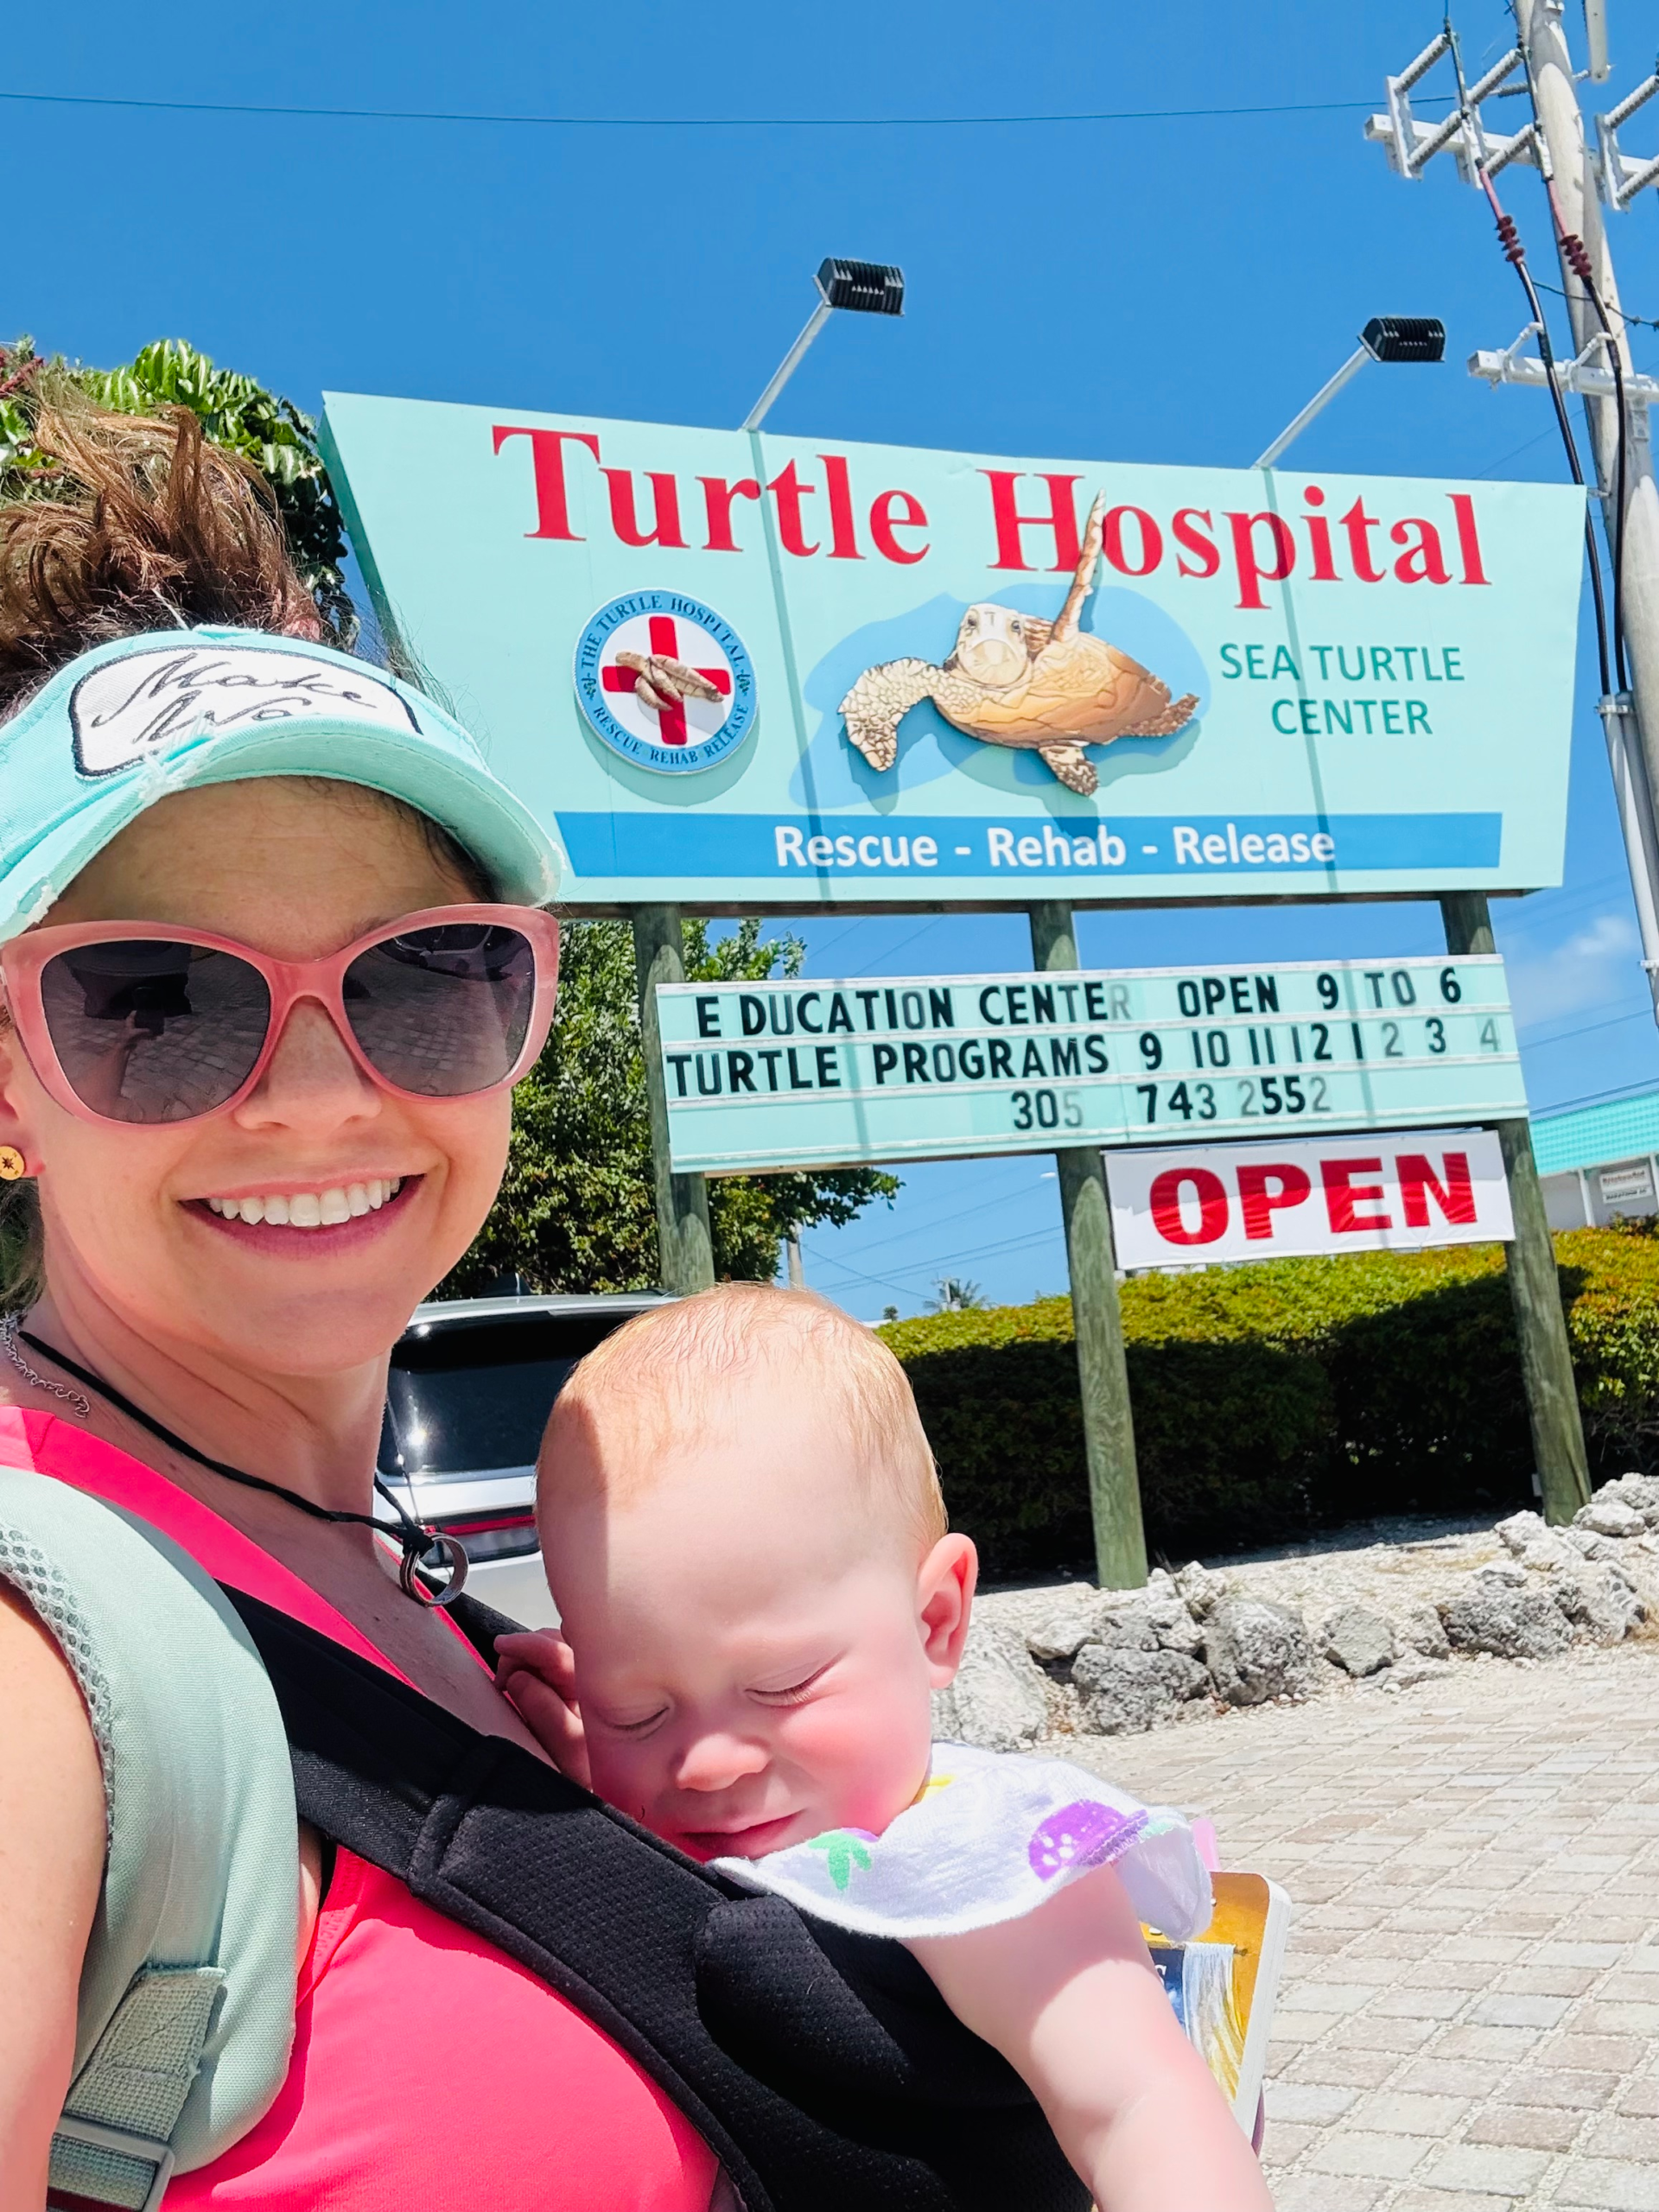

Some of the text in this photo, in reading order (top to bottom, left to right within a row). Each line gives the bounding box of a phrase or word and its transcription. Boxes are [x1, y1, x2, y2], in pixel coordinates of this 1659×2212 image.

[492, 424, 1492, 610] Turtle Hospital
[581, 594, 747, 669] THE TURTLE HOSPITAL
[1219, 643, 1465, 682] SEA TURTLE
[593, 703, 749, 764] RESCUE REHAB RELEASE
[1271, 699, 1433, 734] CENTER
[775, 825, 938, 868] Rescue
[987, 824, 1126, 866] Rehab
[1173, 823, 1336, 864] Release
[979, 982, 1131, 1025] CENTER
[1177, 975, 1281, 1018] OPEN
[1317, 973, 1339, 1009] 9
[1364, 969, 1417, 1009] TO
[1440, 966, 1462, 1003] 6
[666, 1046, 841, 1096] TURTLE
[873, 1033, 1109, 1085] PROGRAMS
[1139, 1032, 1163, 1070] 9
[1382, 1020, 1404, 1057] 2
[1426, 1017, 1446, 1053] 3
[1480, 1017, 1500, 1052] 4
[1011, 1075, 1332, 1130] 305 743 2552
[1149, 1152, 1478, 1245] OPEN
